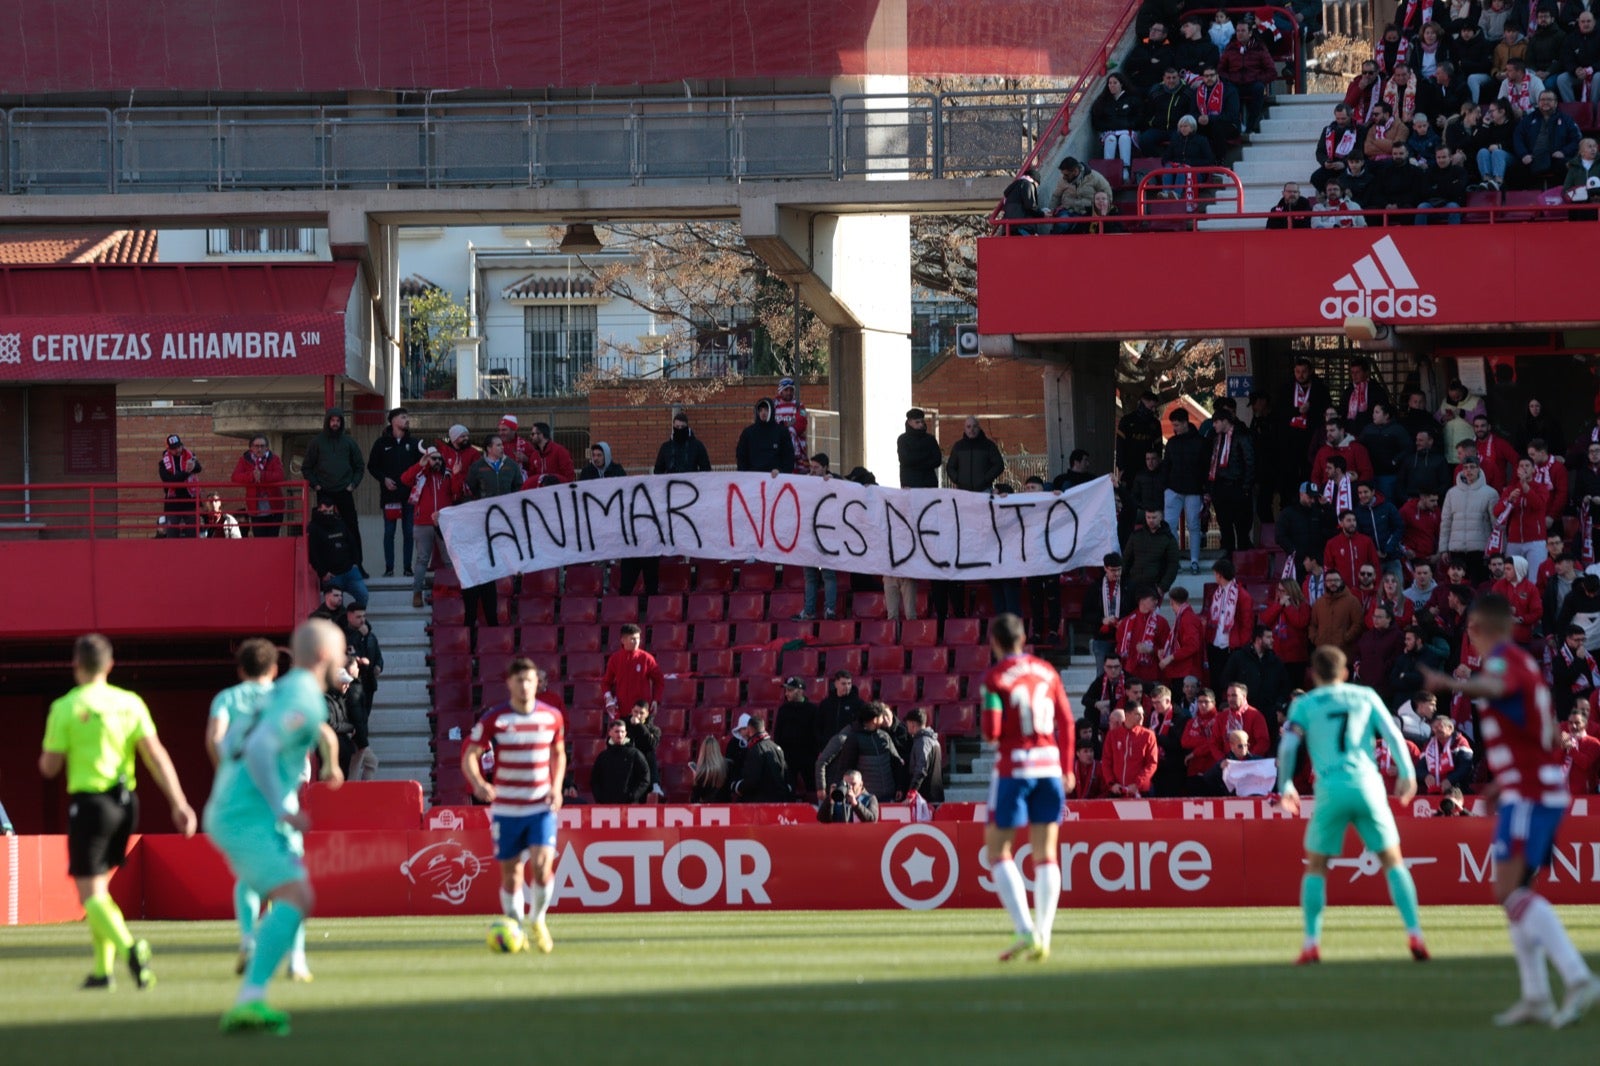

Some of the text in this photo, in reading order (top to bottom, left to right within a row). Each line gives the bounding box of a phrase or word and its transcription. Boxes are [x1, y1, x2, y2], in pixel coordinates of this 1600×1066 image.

[1319, 287, 1438, 320] adidas
[32, 330, 321, 362] CERVEZAS ALHAMBRA SIN
[484, 479, 1079, 569] ANIMAR NO ES DELITO
[1010, 681, 1055, 737] 16
[1326, 709, 1350, 754] 7
